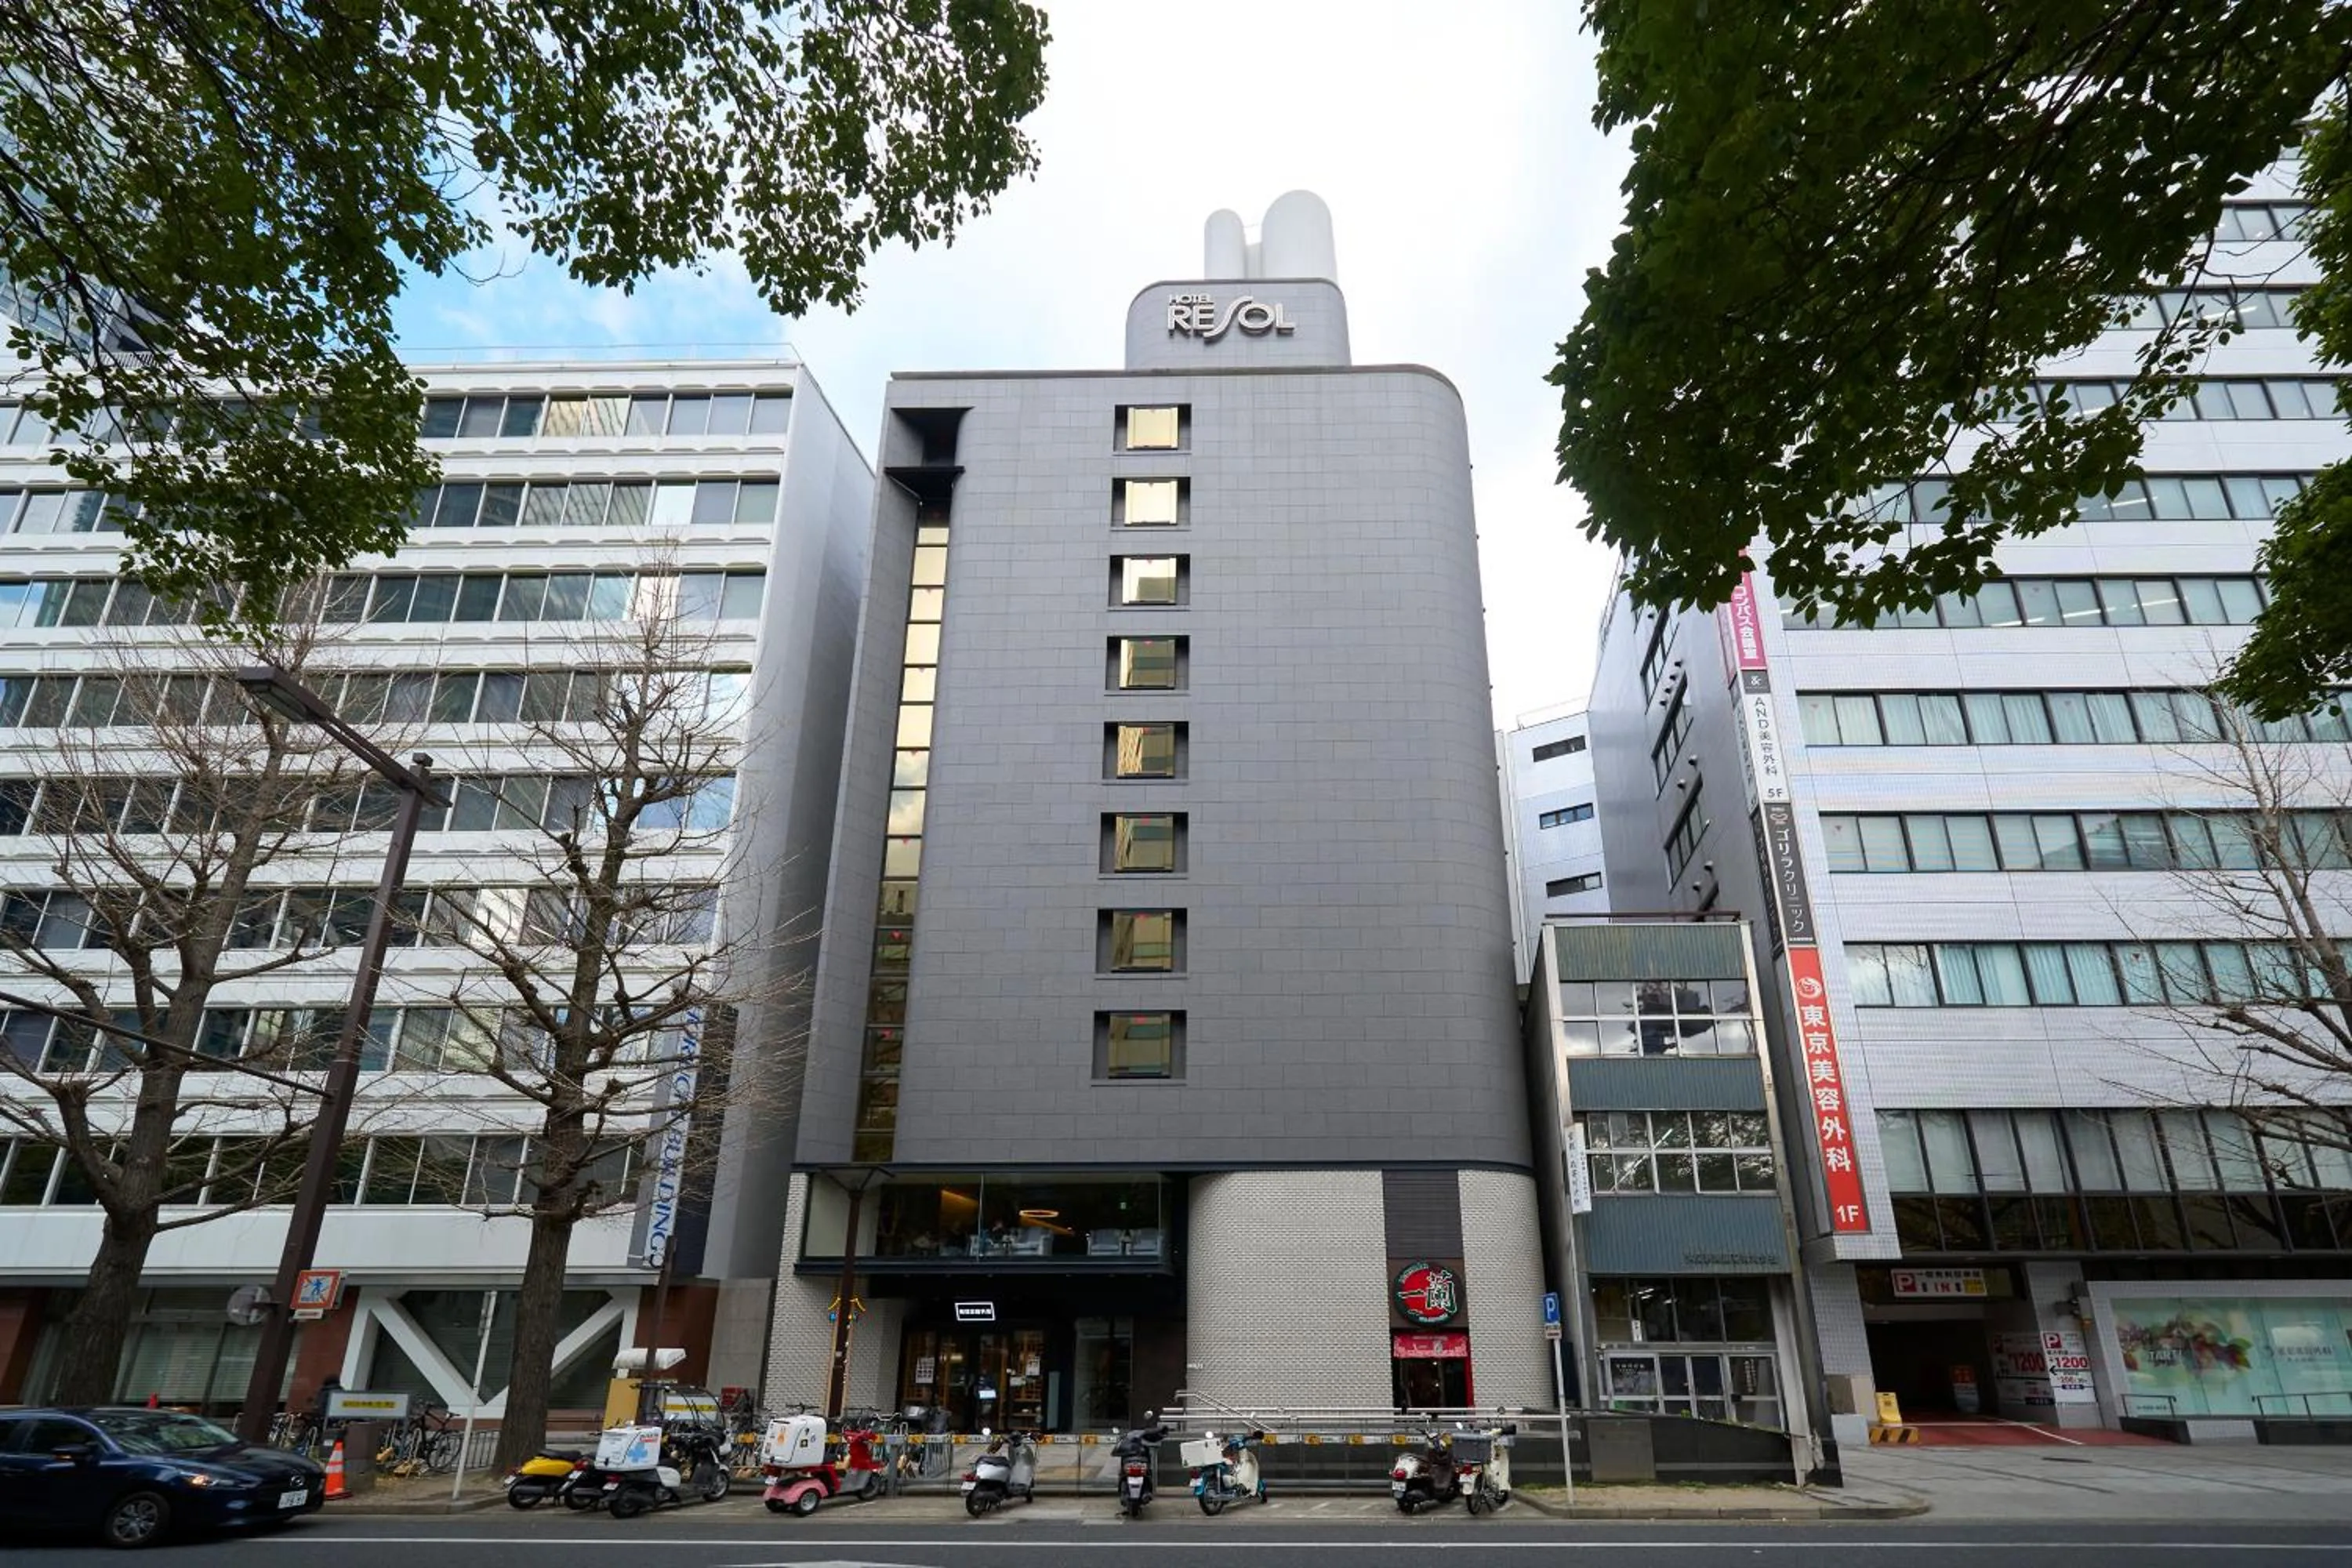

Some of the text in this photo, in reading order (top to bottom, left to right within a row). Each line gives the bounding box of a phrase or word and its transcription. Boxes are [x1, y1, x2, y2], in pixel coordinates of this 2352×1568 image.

[1168, 294, 1213, 304] HOTEL
[1167, 296, 1296, 338] RESOL
[1755, 697, 1778, 775] AND美容外科
[1768, 788, 1783, 797] 5F
[1776, 828, 1804, 932] ゴリラクリニック
[1800, 1004, 1851, 1173] 東京美容外科
[1836, 1205, 1860, 1224] 1F
[1397, 1269, 1458, 1314] 一蘭
[1545, 1298, 1555, 1319] P
[2045, 1334, 2059, 1348] P
[2055, 1356, 2089, 1368] 1200
